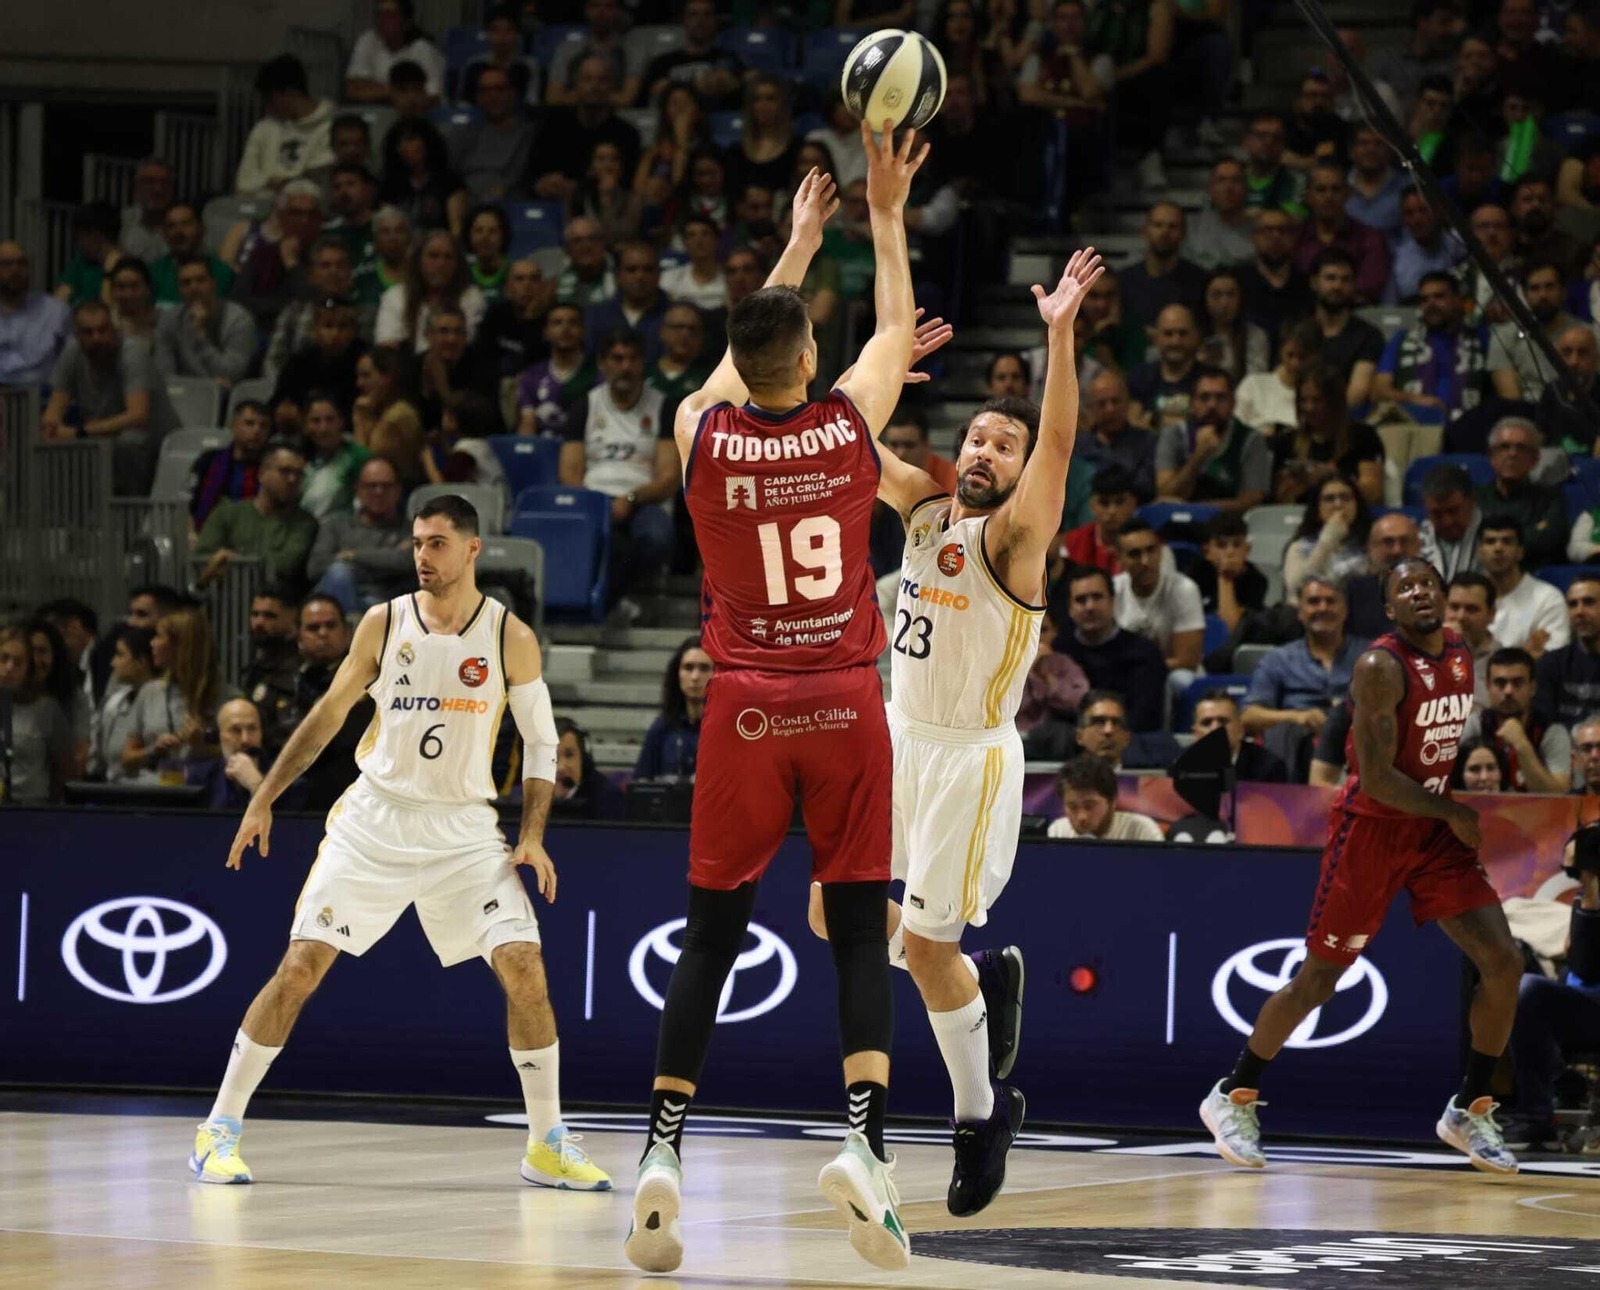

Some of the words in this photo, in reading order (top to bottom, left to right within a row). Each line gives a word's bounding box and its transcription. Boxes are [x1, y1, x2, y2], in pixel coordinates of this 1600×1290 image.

[711, 413, 857, 462] TODOROVIĆ
[763, 472, 827, 487] CARAVACA
[764, 486, 779, 497] DE
[781, 484, 794, 495] LA
[796, 481, 825, 493] CRUZ
[827, 474, 851, 488] 2024
[764, 495, 788, 507] AÑO
[790, 490, 833, 506] JUBILAR
[757, 514, 843, 606] 19
[774, 633, 792, 646] de
[795, 629, 842, 646] Murcia
[893, 608, 934, 660] 23
[390, 697, 489, 714] AUTOHERO
[770, 714, 810, 728] Costa
[814, 707, 858, 722] Cálida
[805, 724, 817, 732] de
[819, 721, 849, 731] Murcia
[418, 723, 446, 760] 6
